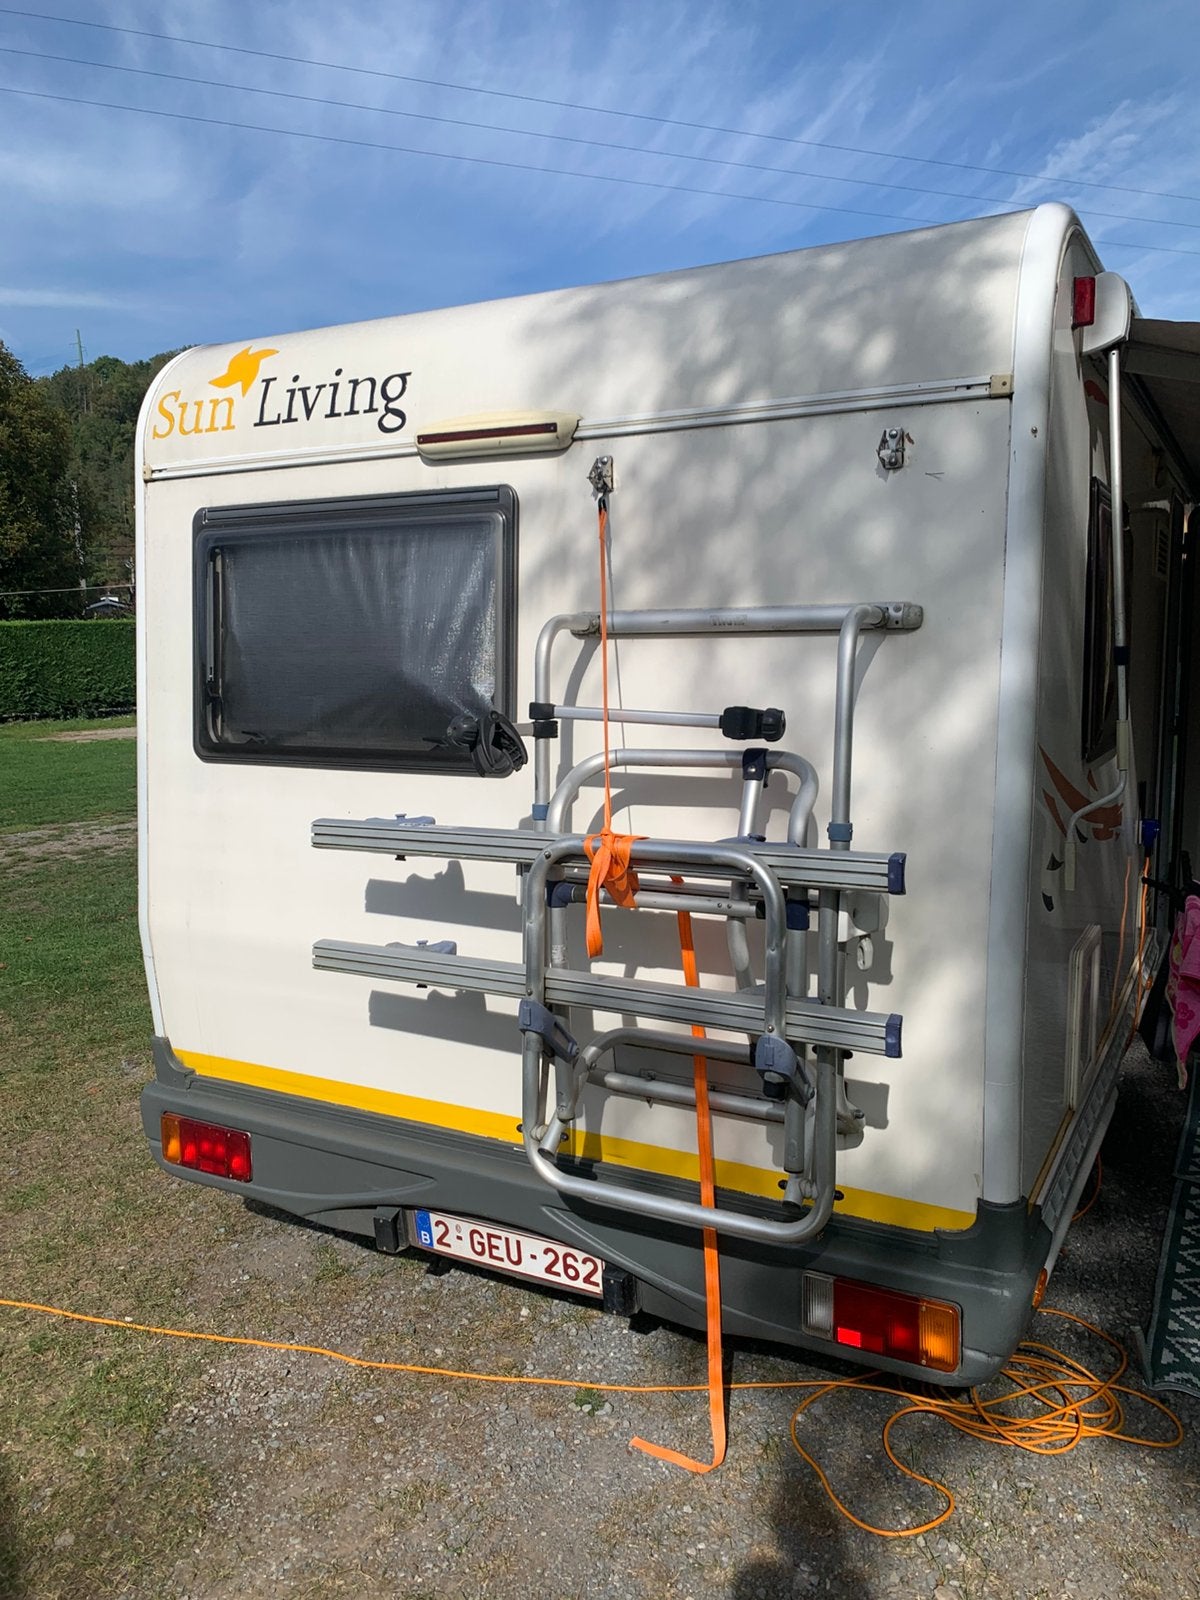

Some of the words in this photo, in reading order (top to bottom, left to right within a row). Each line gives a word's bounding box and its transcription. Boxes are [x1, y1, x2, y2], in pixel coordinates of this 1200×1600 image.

[152, 390, 236, 440] Sun
[253, 368, 412, 434] Living
[421, 1231, 431, 1245] B
